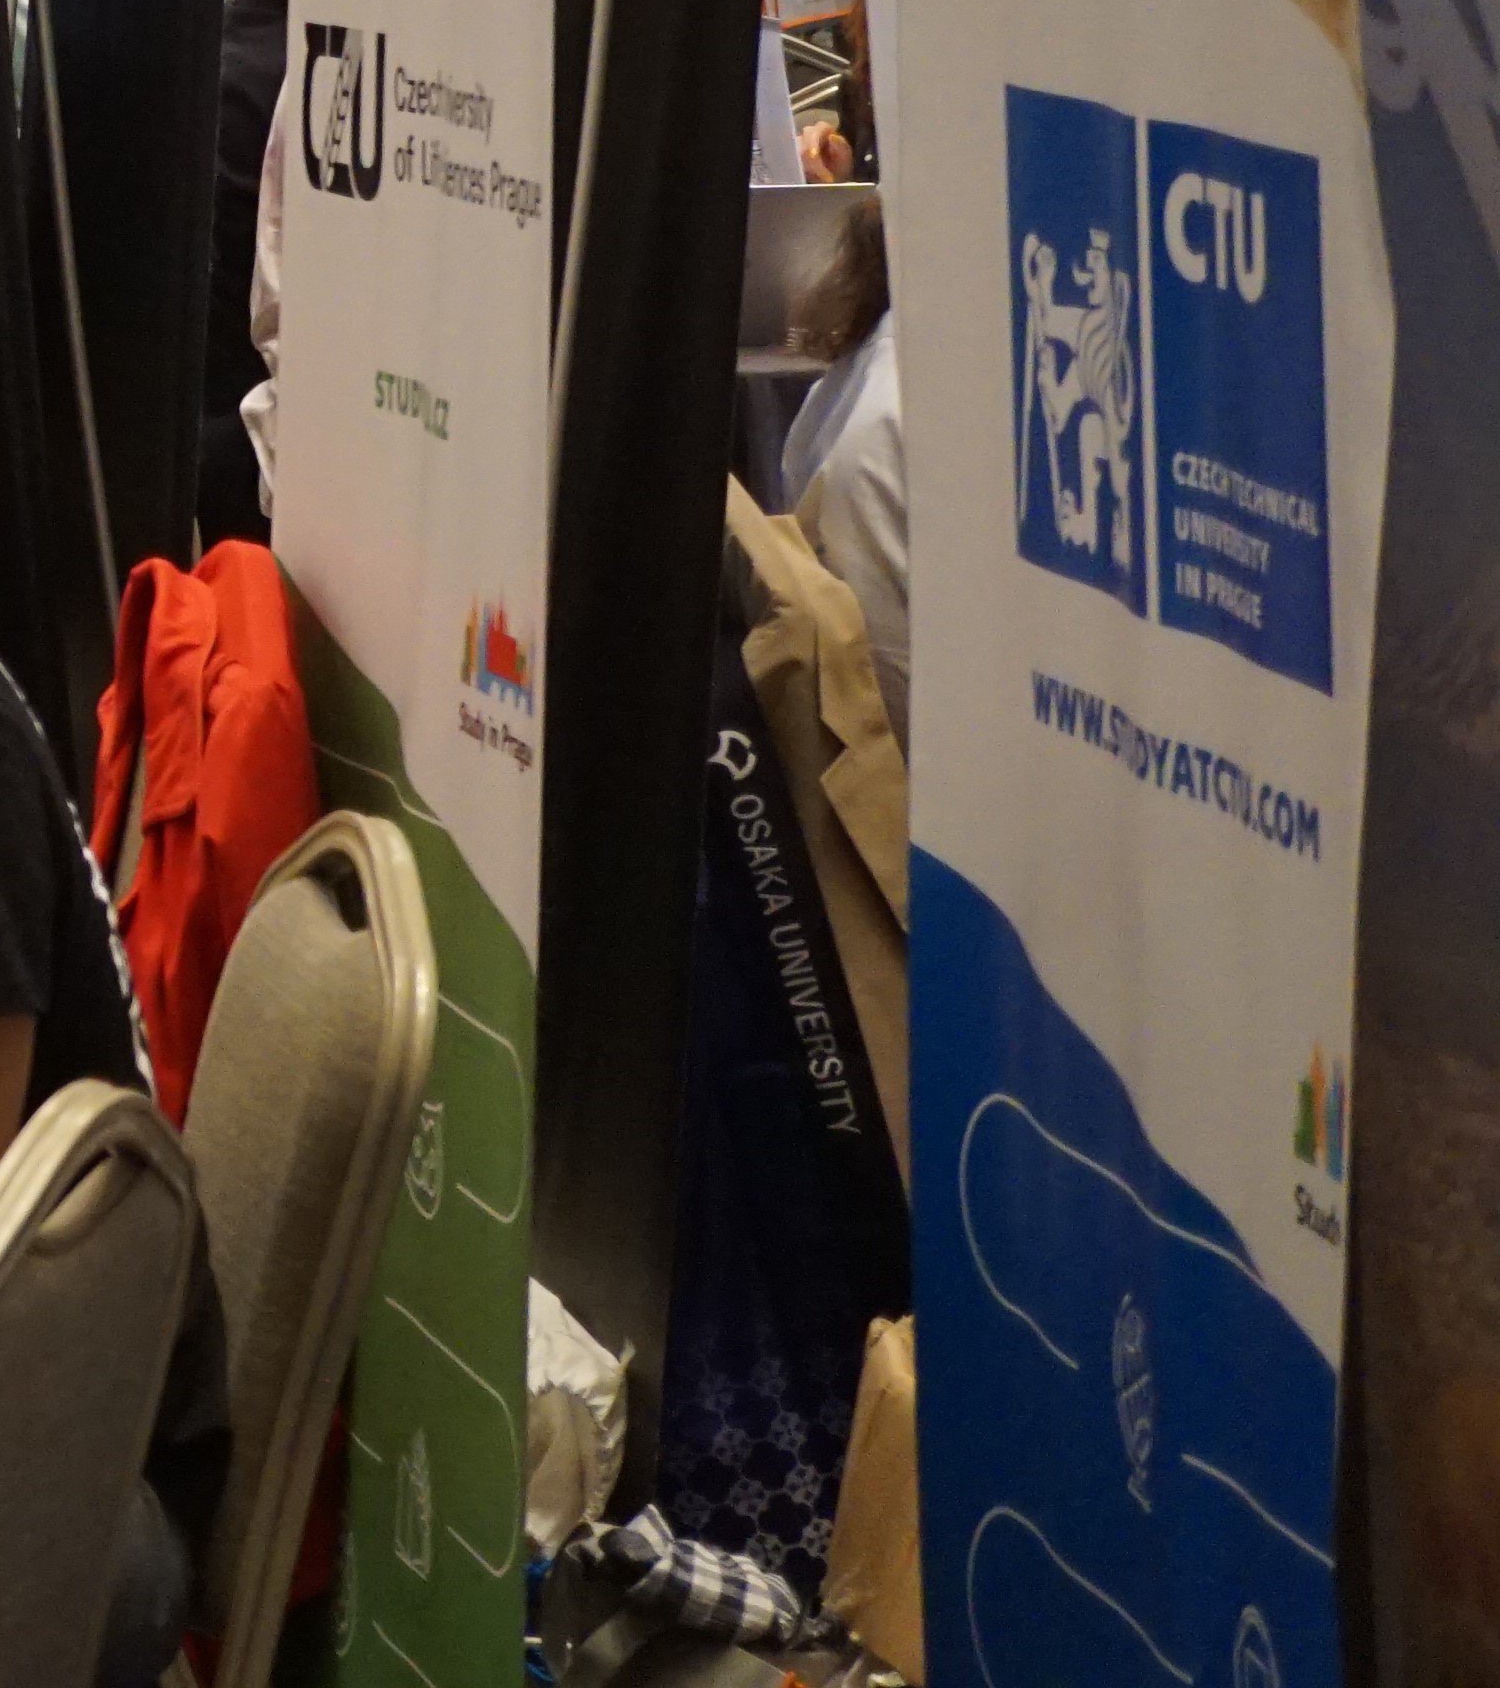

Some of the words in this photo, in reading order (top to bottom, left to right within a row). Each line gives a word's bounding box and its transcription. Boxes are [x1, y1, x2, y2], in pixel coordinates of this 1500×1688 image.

[1163, 171, 1269, 305] CTU
[729, 792, 795, 916] OSAKA
[768, 920, 863, 1135] UNIVERSITY
